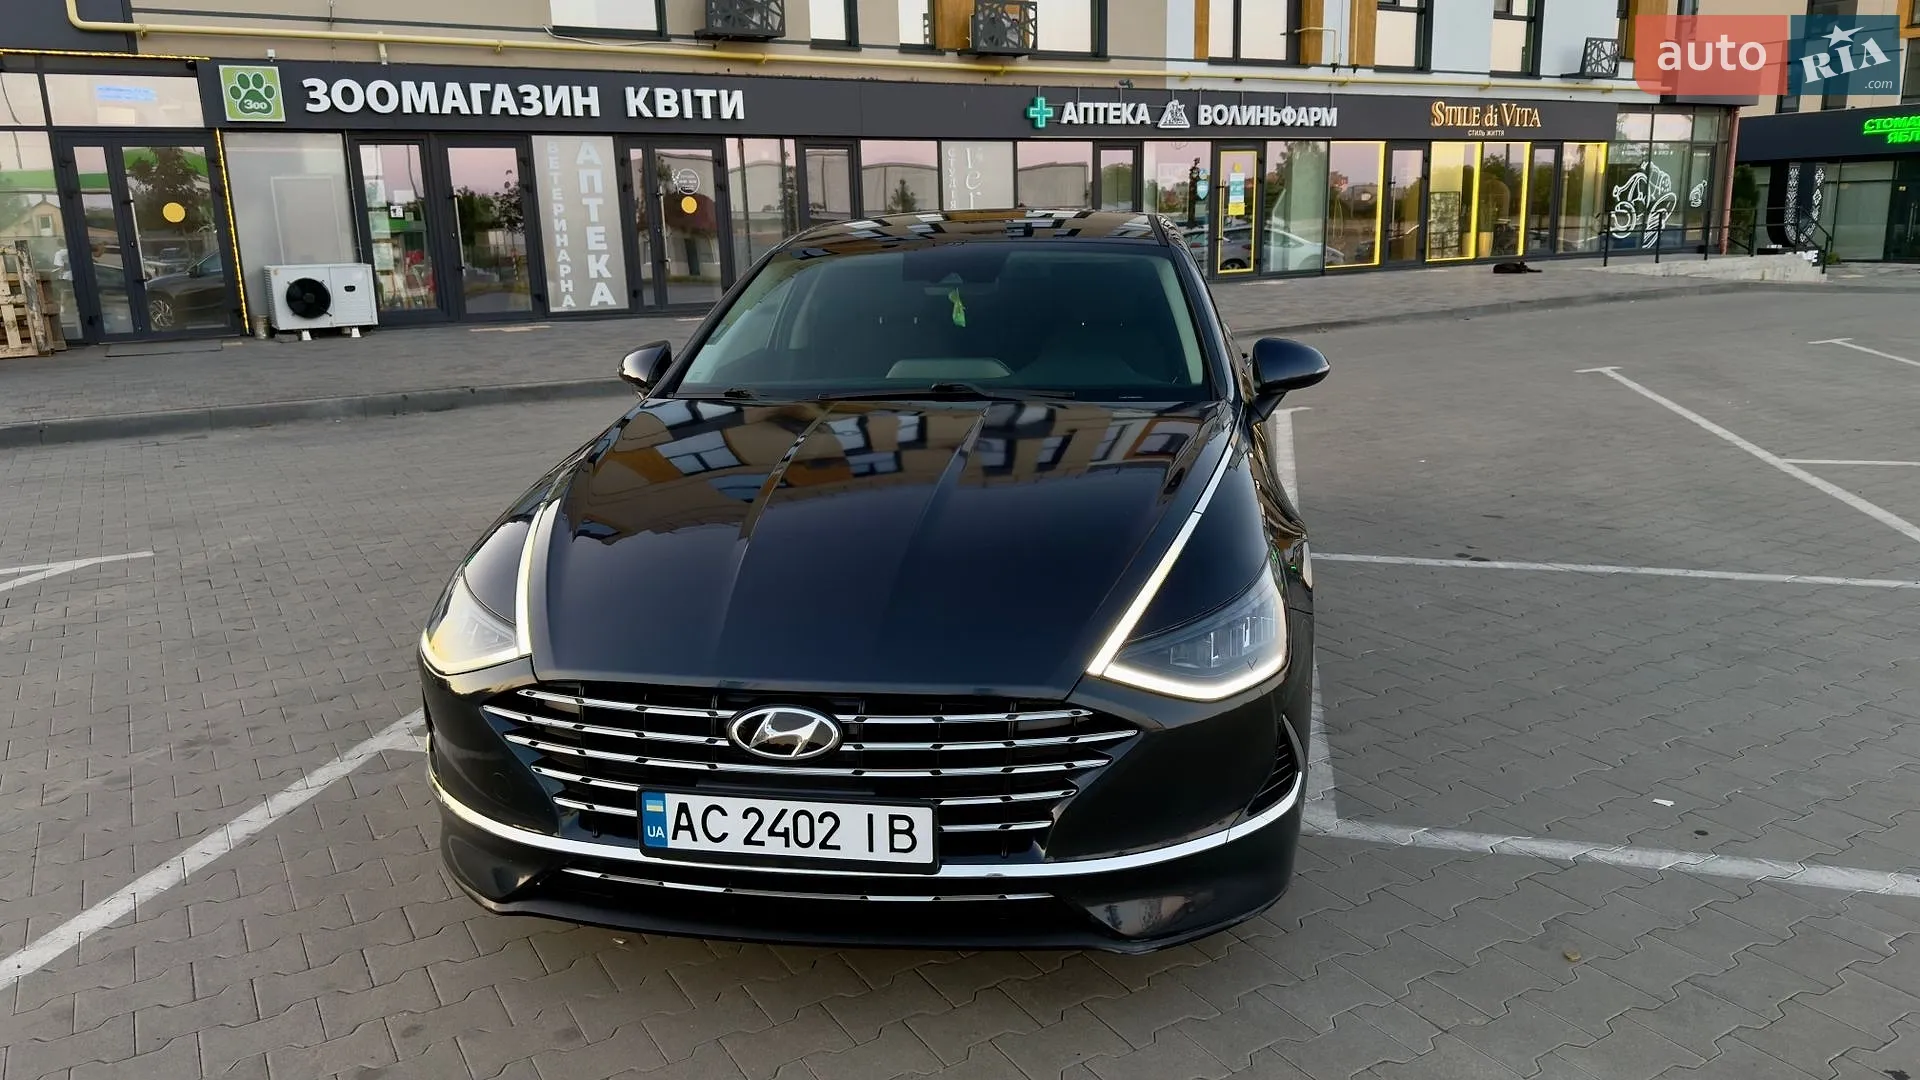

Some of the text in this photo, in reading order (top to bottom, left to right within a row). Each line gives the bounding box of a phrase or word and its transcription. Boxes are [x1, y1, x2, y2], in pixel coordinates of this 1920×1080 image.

[302, 77, 745, 120] ЗООМАГАЗИН КВІТИ
[1060, 101, 1338, 128] АПТЕКА ВОЛИНЬФАРМ
[1484, 104, 1499, 127] di
[1501, 103, 1542, 127] VITA
[1864, 116, 1920, 130] СТОМА
[547, 141, 577, 308] ВЕТЕРИНАРНА
[576, 141, 617, 307] АПТЕКА
[647, 826, 665, 839] UA
[671, 802, 728, 843] AC
[742, 806, 841, 850] 2402
